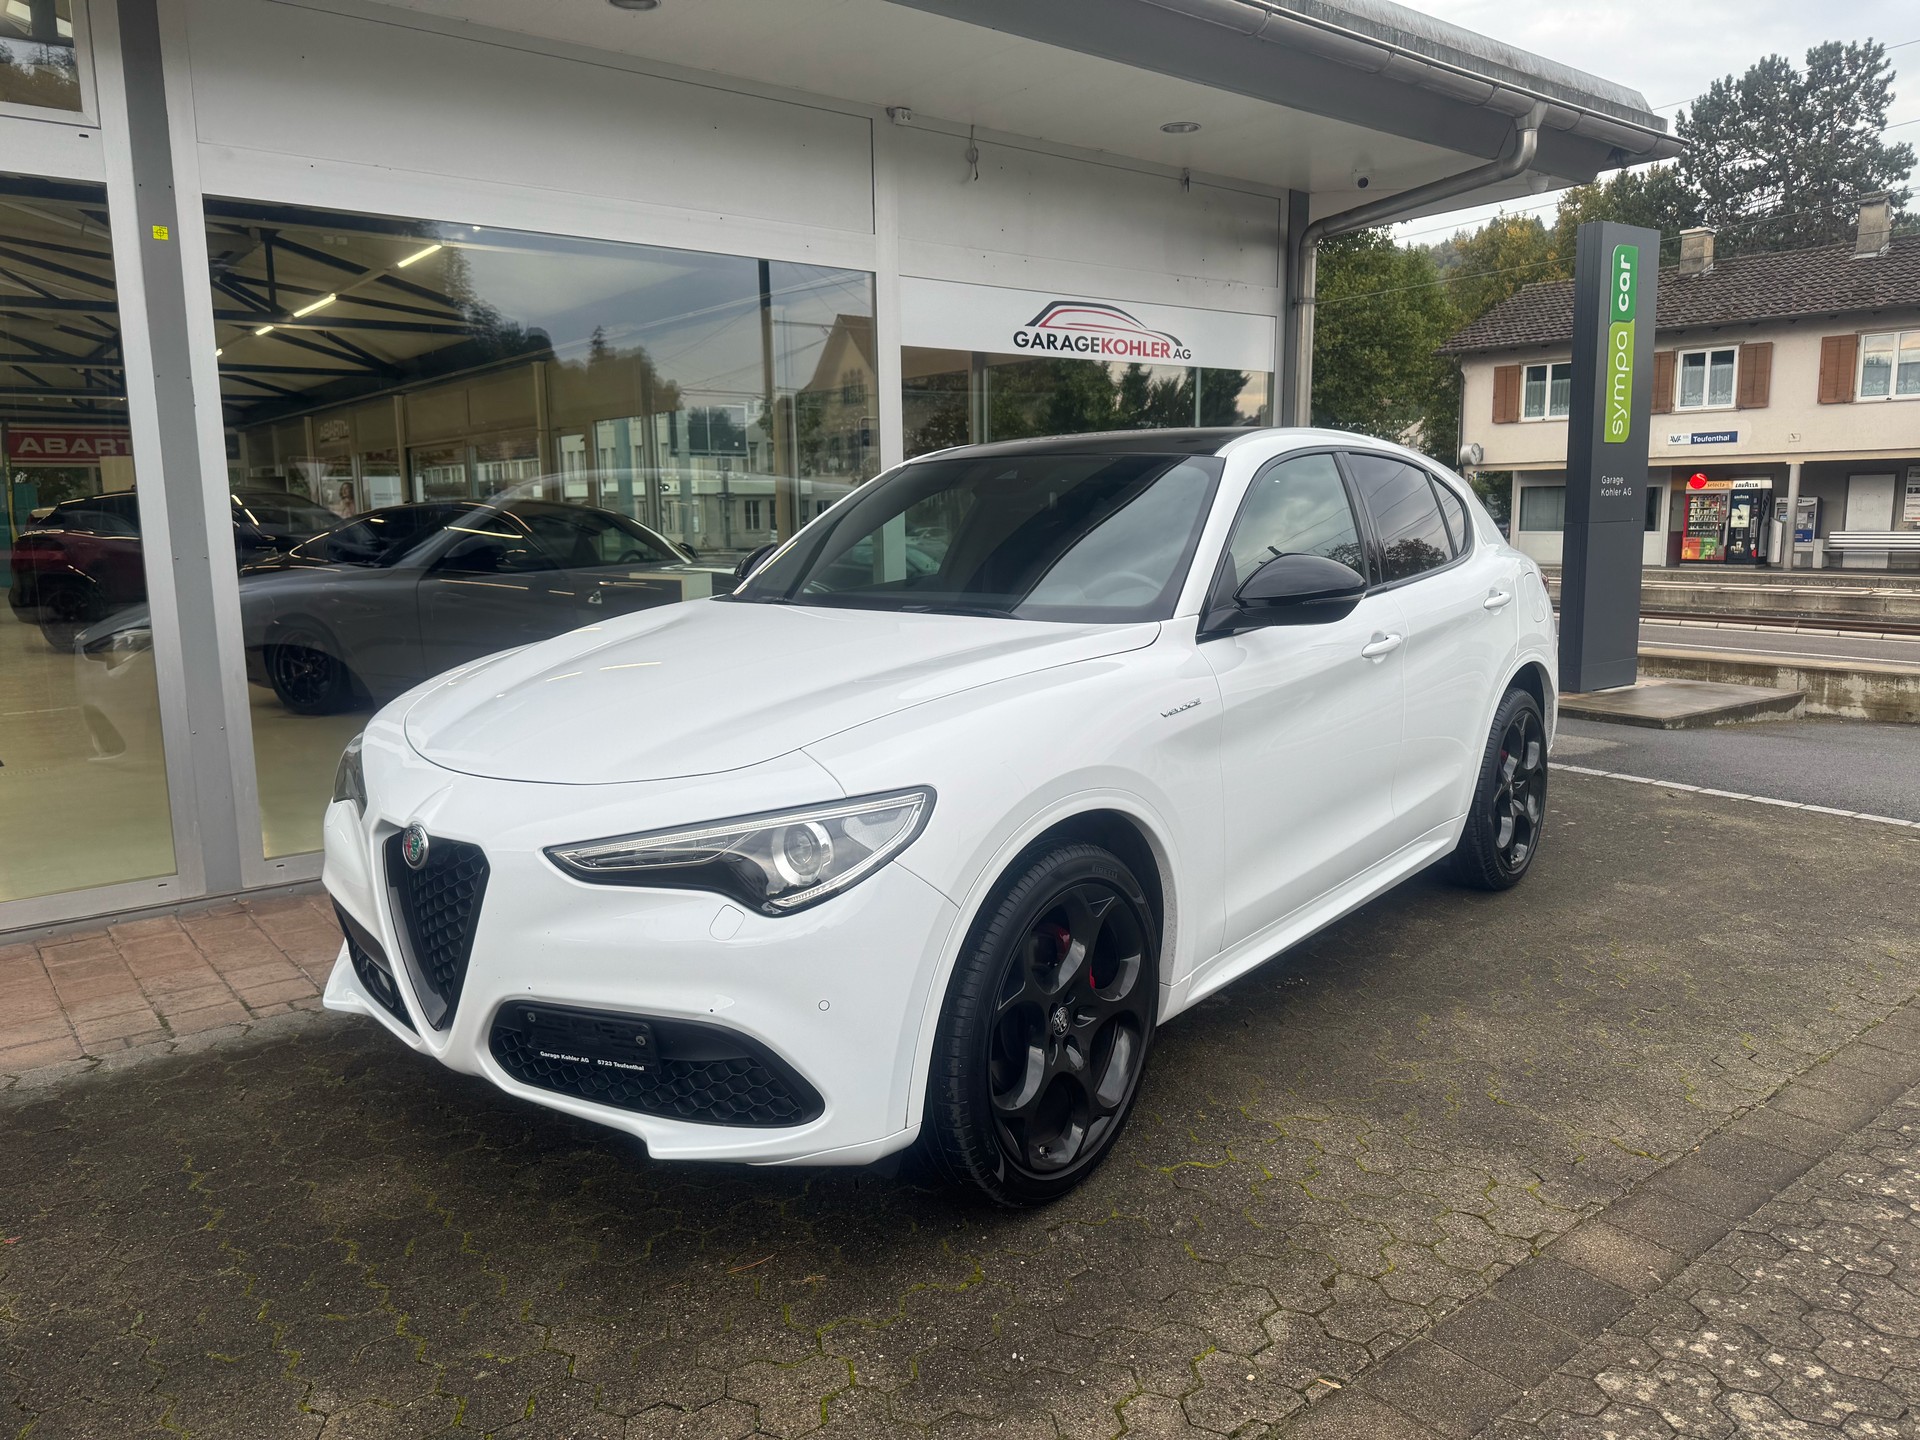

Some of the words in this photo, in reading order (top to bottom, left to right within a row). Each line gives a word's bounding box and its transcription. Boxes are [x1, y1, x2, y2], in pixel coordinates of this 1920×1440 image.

[1618, 253, 1631, 312] car
[1173, 348, 1192, 360] AG
[1612, 330, 1630, 435] sympa
[1693, 435, 1730, 443] Teufenthal
[1601, 475, 1624, 486] Garage
[1600, 487, 1622, 497] Kohler
[1622, 487, 1632, 496] AG
[540, 1051, 560, 1060] Garage
[561, 1054, 580, 1062] Kohler
[613, 1061, 645, 1072] Teufenthal
